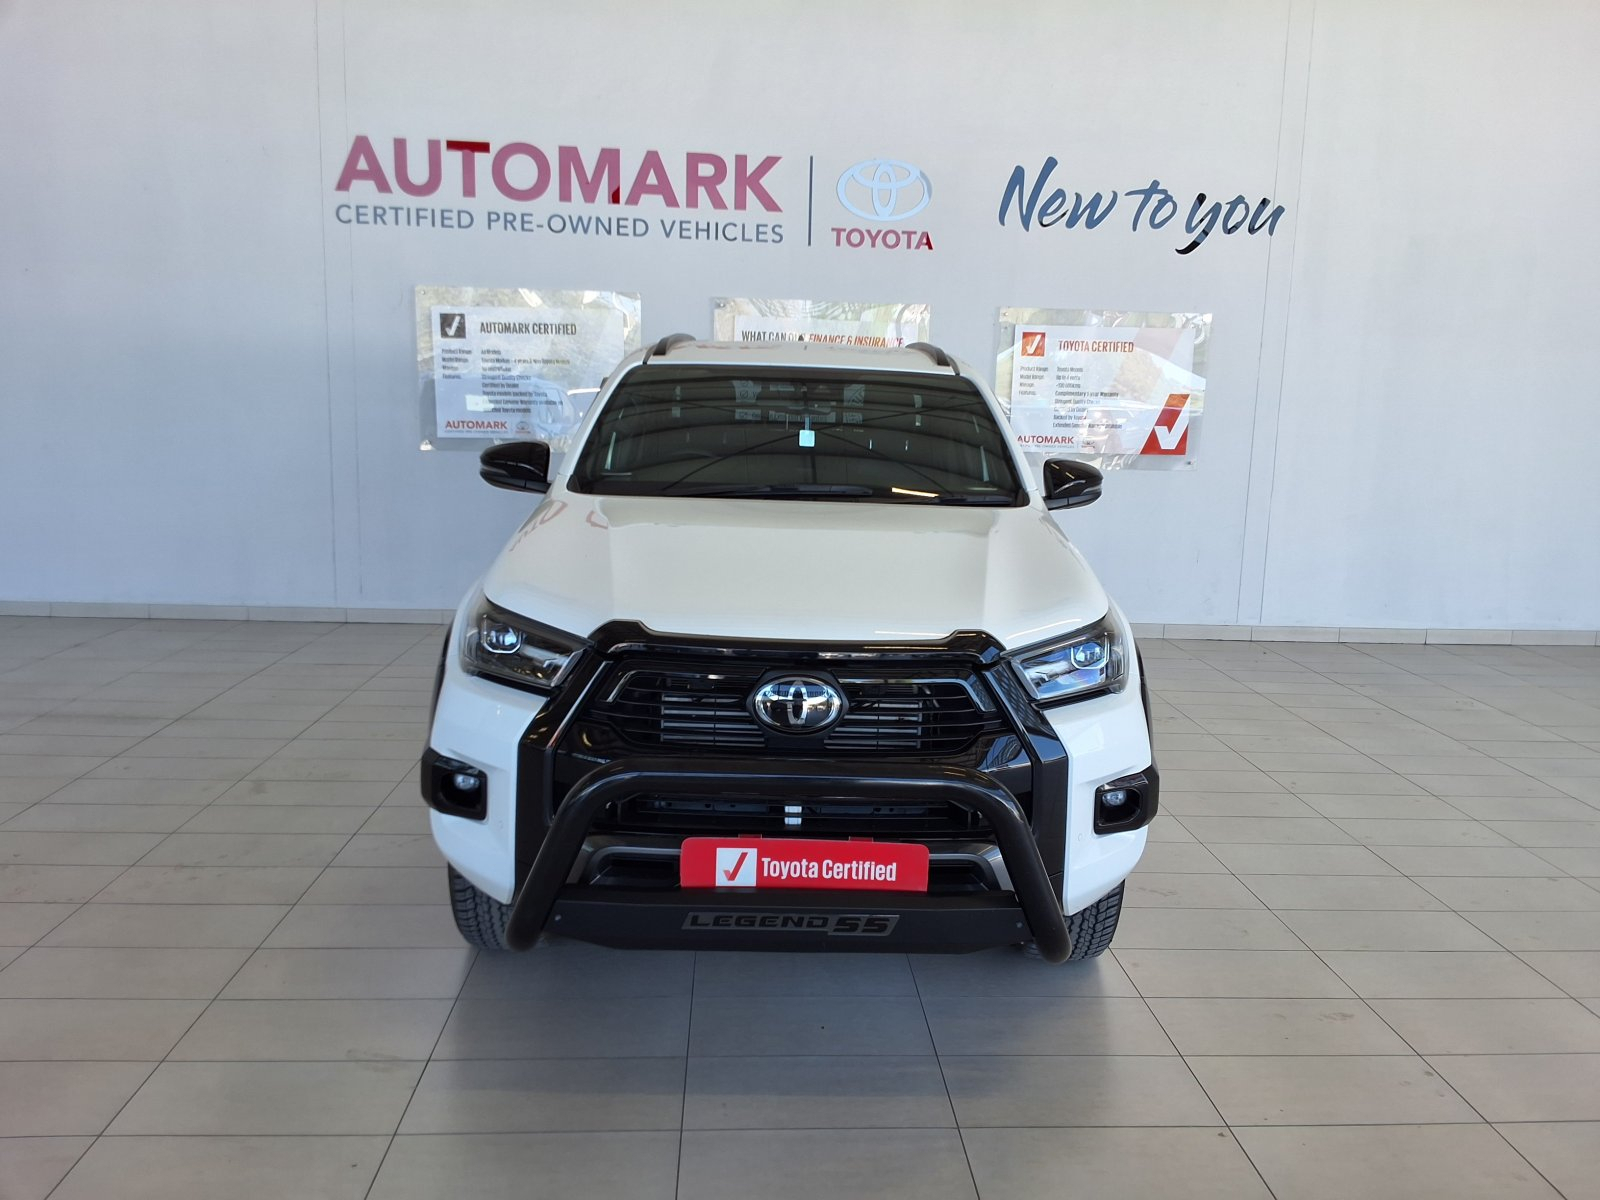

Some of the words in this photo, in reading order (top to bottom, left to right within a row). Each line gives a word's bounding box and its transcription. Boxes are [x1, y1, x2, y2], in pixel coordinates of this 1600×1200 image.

[335, 134, 784, 213] AUTOMARK
[998, 156, 1118, 232] New
[1124, 179, 1178, 232] to
[1174, 192, 1286, 255] you
[334, 204, 475, 230] CERTIFIED
[486, 211, 650, 239] PRE-OWNED
[659, 219, 785, 245] VEHICLES
[830, 227, 934, 251] TOYOTA
[479, 322, 531, 335] AUTOMARK
[532, 322, 577, 336] CERTIFIED
[741, 330, 767, 342] WHAT
[768, 331, 787, 343] CAN
[808, 333, 845, 345] FINANCE
[1058, 340, 1090, 352] TOYOTA
[1091, 341, 1135, 353] CERTIFIED
[445, 420, 508, 430] AUTOMARK
[1017, 435, 1074, 444] AUTOMARK
[761, 857, 818, 882] Toyota
[822, 858, 897, 882] Certified
[688, 913, 829, 929] LEGEND
[831, 917, 891, 934] SS
